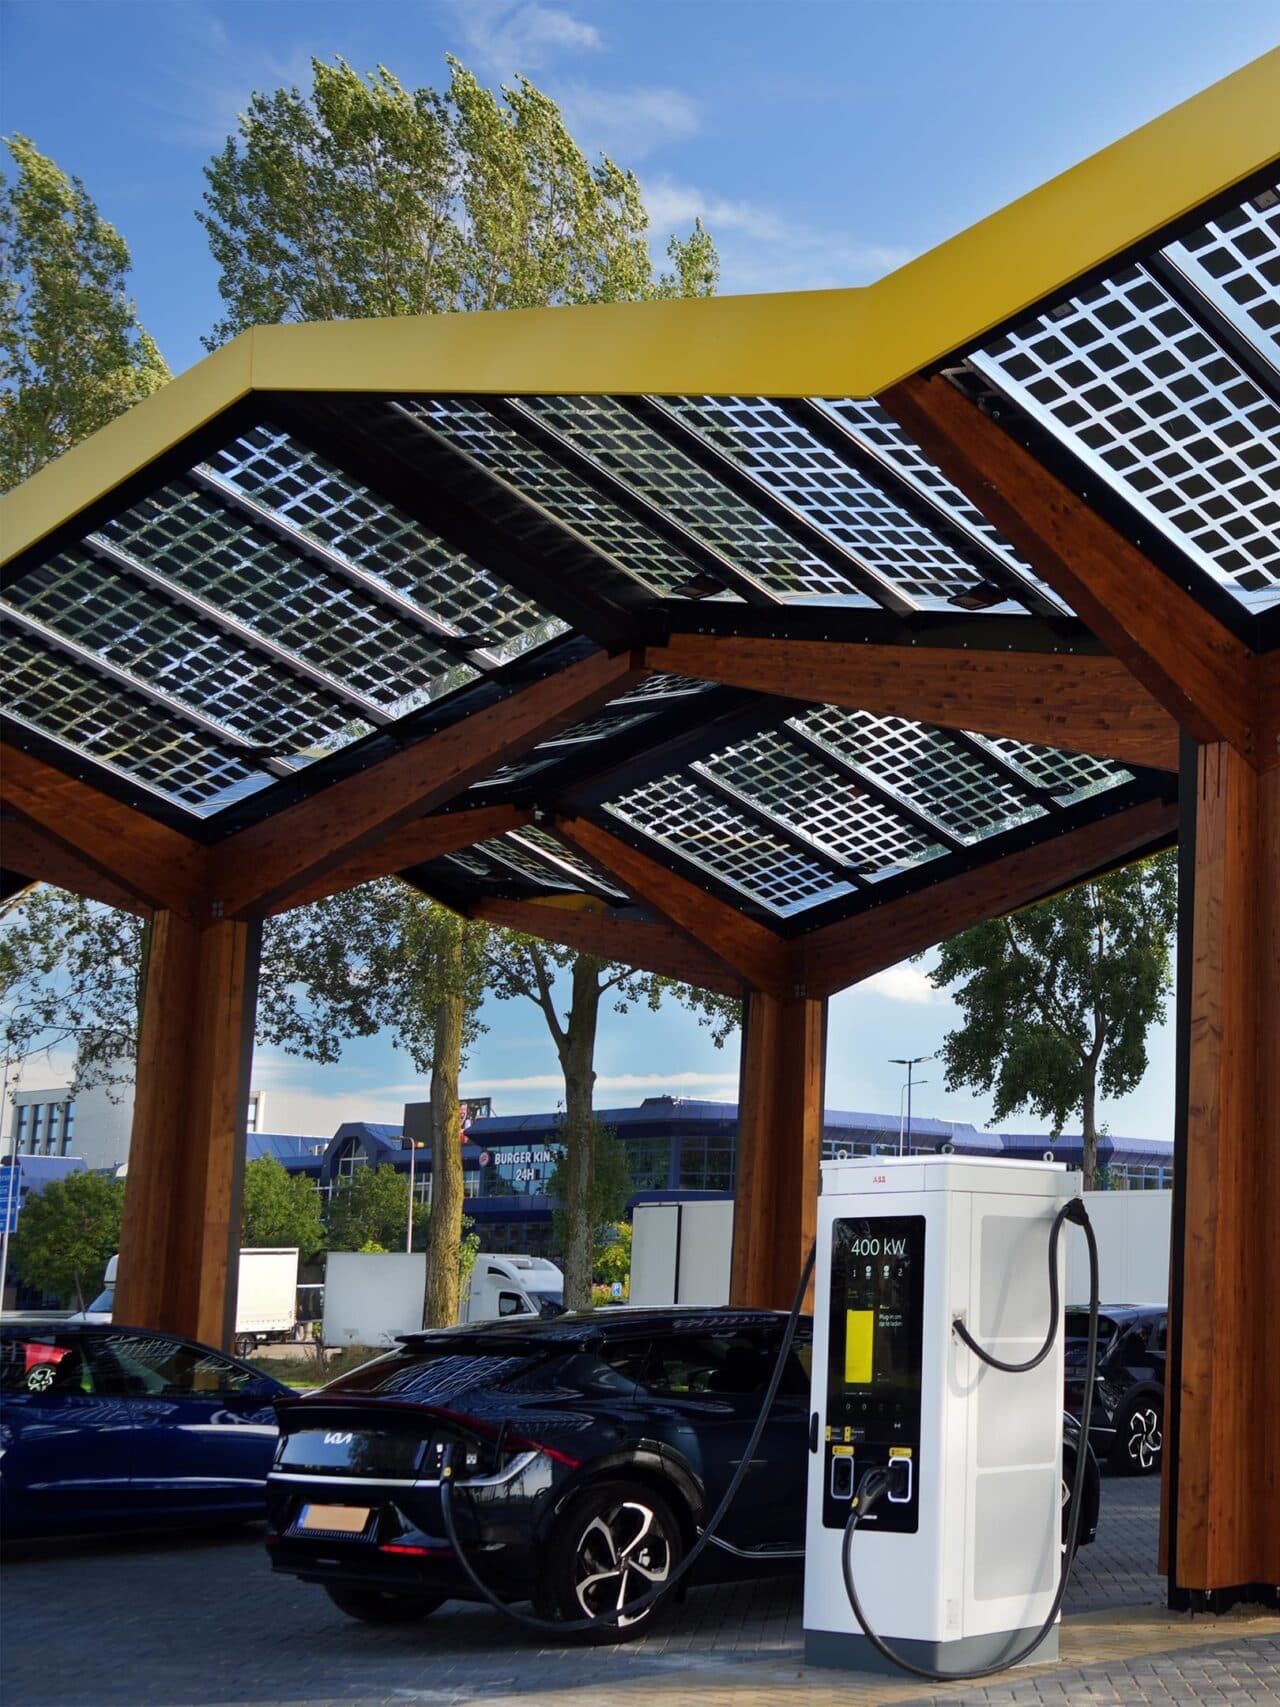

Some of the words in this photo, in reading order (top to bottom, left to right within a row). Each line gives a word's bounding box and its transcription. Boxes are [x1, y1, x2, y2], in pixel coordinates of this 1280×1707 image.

[495, 1152, 531, 1165] BURGER
[515, 1168, 535, 1181] 24H
[851, 1238, 880, 1256] 400
[883, 1238, 906, 1256] kW
[323, 1432, 353, 1444] KIA
